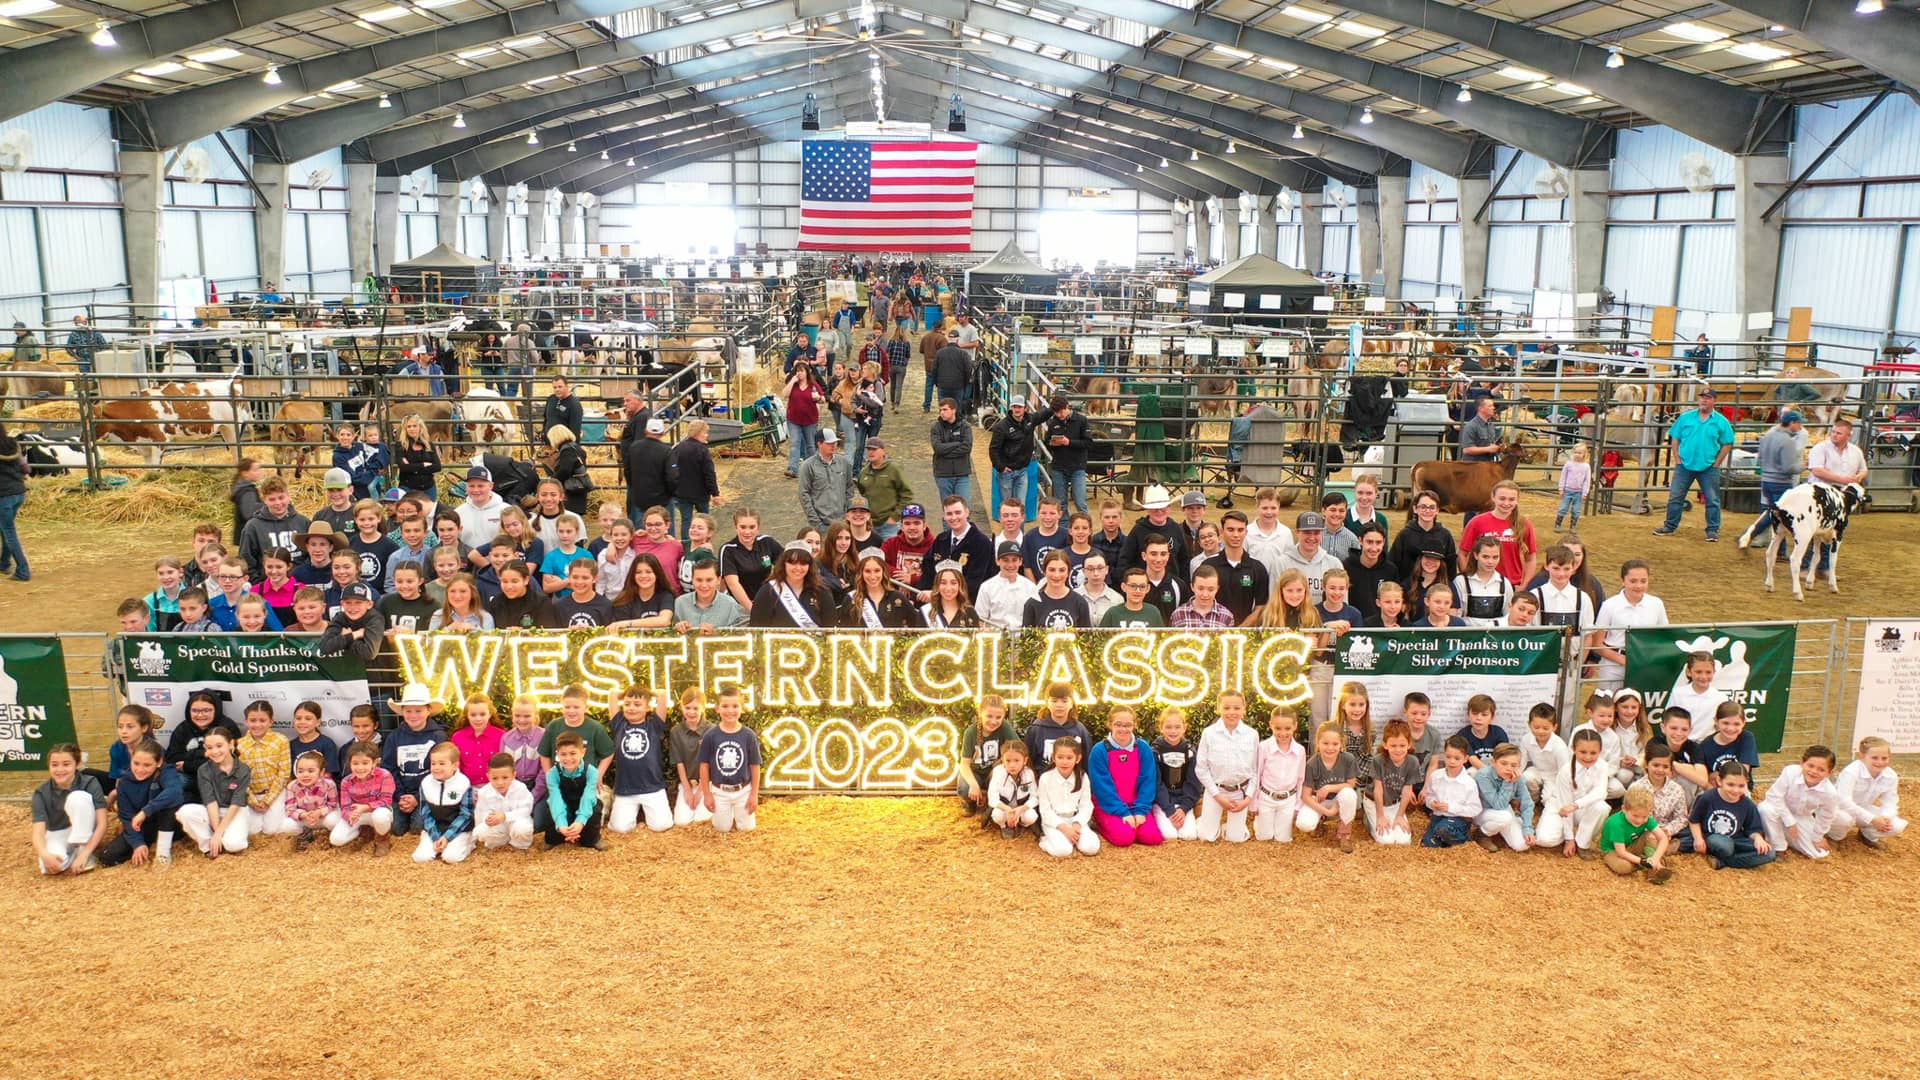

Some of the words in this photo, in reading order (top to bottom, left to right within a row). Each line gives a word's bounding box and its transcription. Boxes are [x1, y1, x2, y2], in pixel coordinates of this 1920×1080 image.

[178, 644, 231, 660] Special
[238, 643, 297, 659] Thanks
[1387, 638, 1439, 654] Special
[1446, 637, 1498, 651] Thanks
[1501, 639, 1515, 651] to
[1518, 637, 1546, 651] Our
[211, 660, 244, 674] Gold
[248, 661, 319, 677] Sponsors
[1411, 653, 1452, 667] Silver
[1454, 654, 1520, 669] Sponsors
[395, 632, 895, 710] WESTERN
[903, 631, 1314, 708] CLASSIC
[8, 750, 41, 761] Show
[763, 717, 961, 788] 2023
